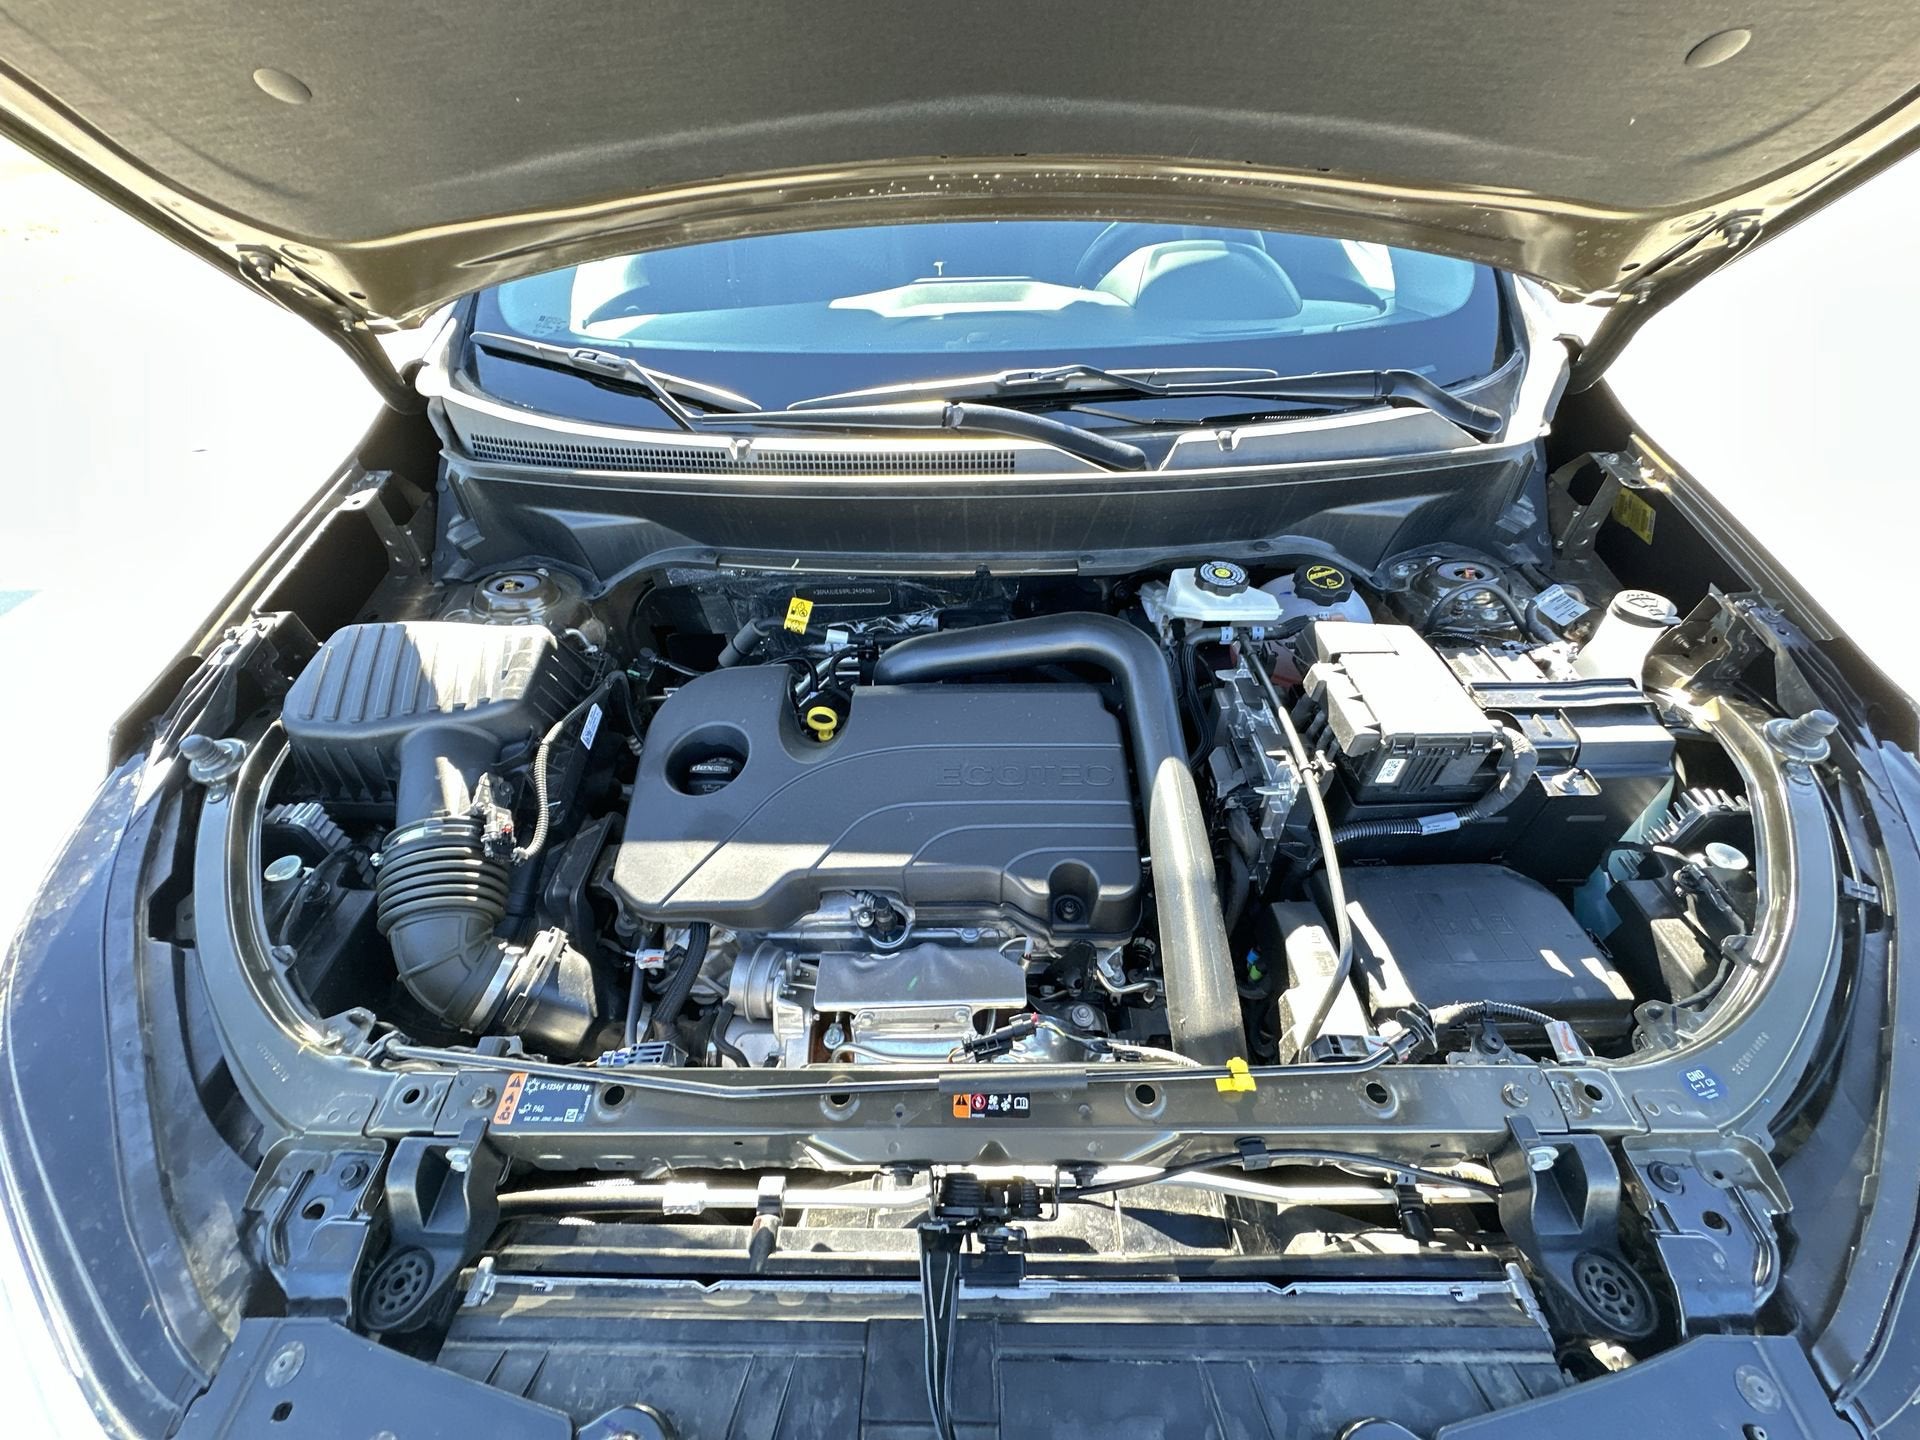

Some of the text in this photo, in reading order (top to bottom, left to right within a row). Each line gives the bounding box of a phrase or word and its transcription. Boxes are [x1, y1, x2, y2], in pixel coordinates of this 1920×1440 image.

[936, 765, 1114, 787] ECOTEC
[1686, 1069, 1705, 1082] GND
[532, 1104, 545, 1113] PAG
